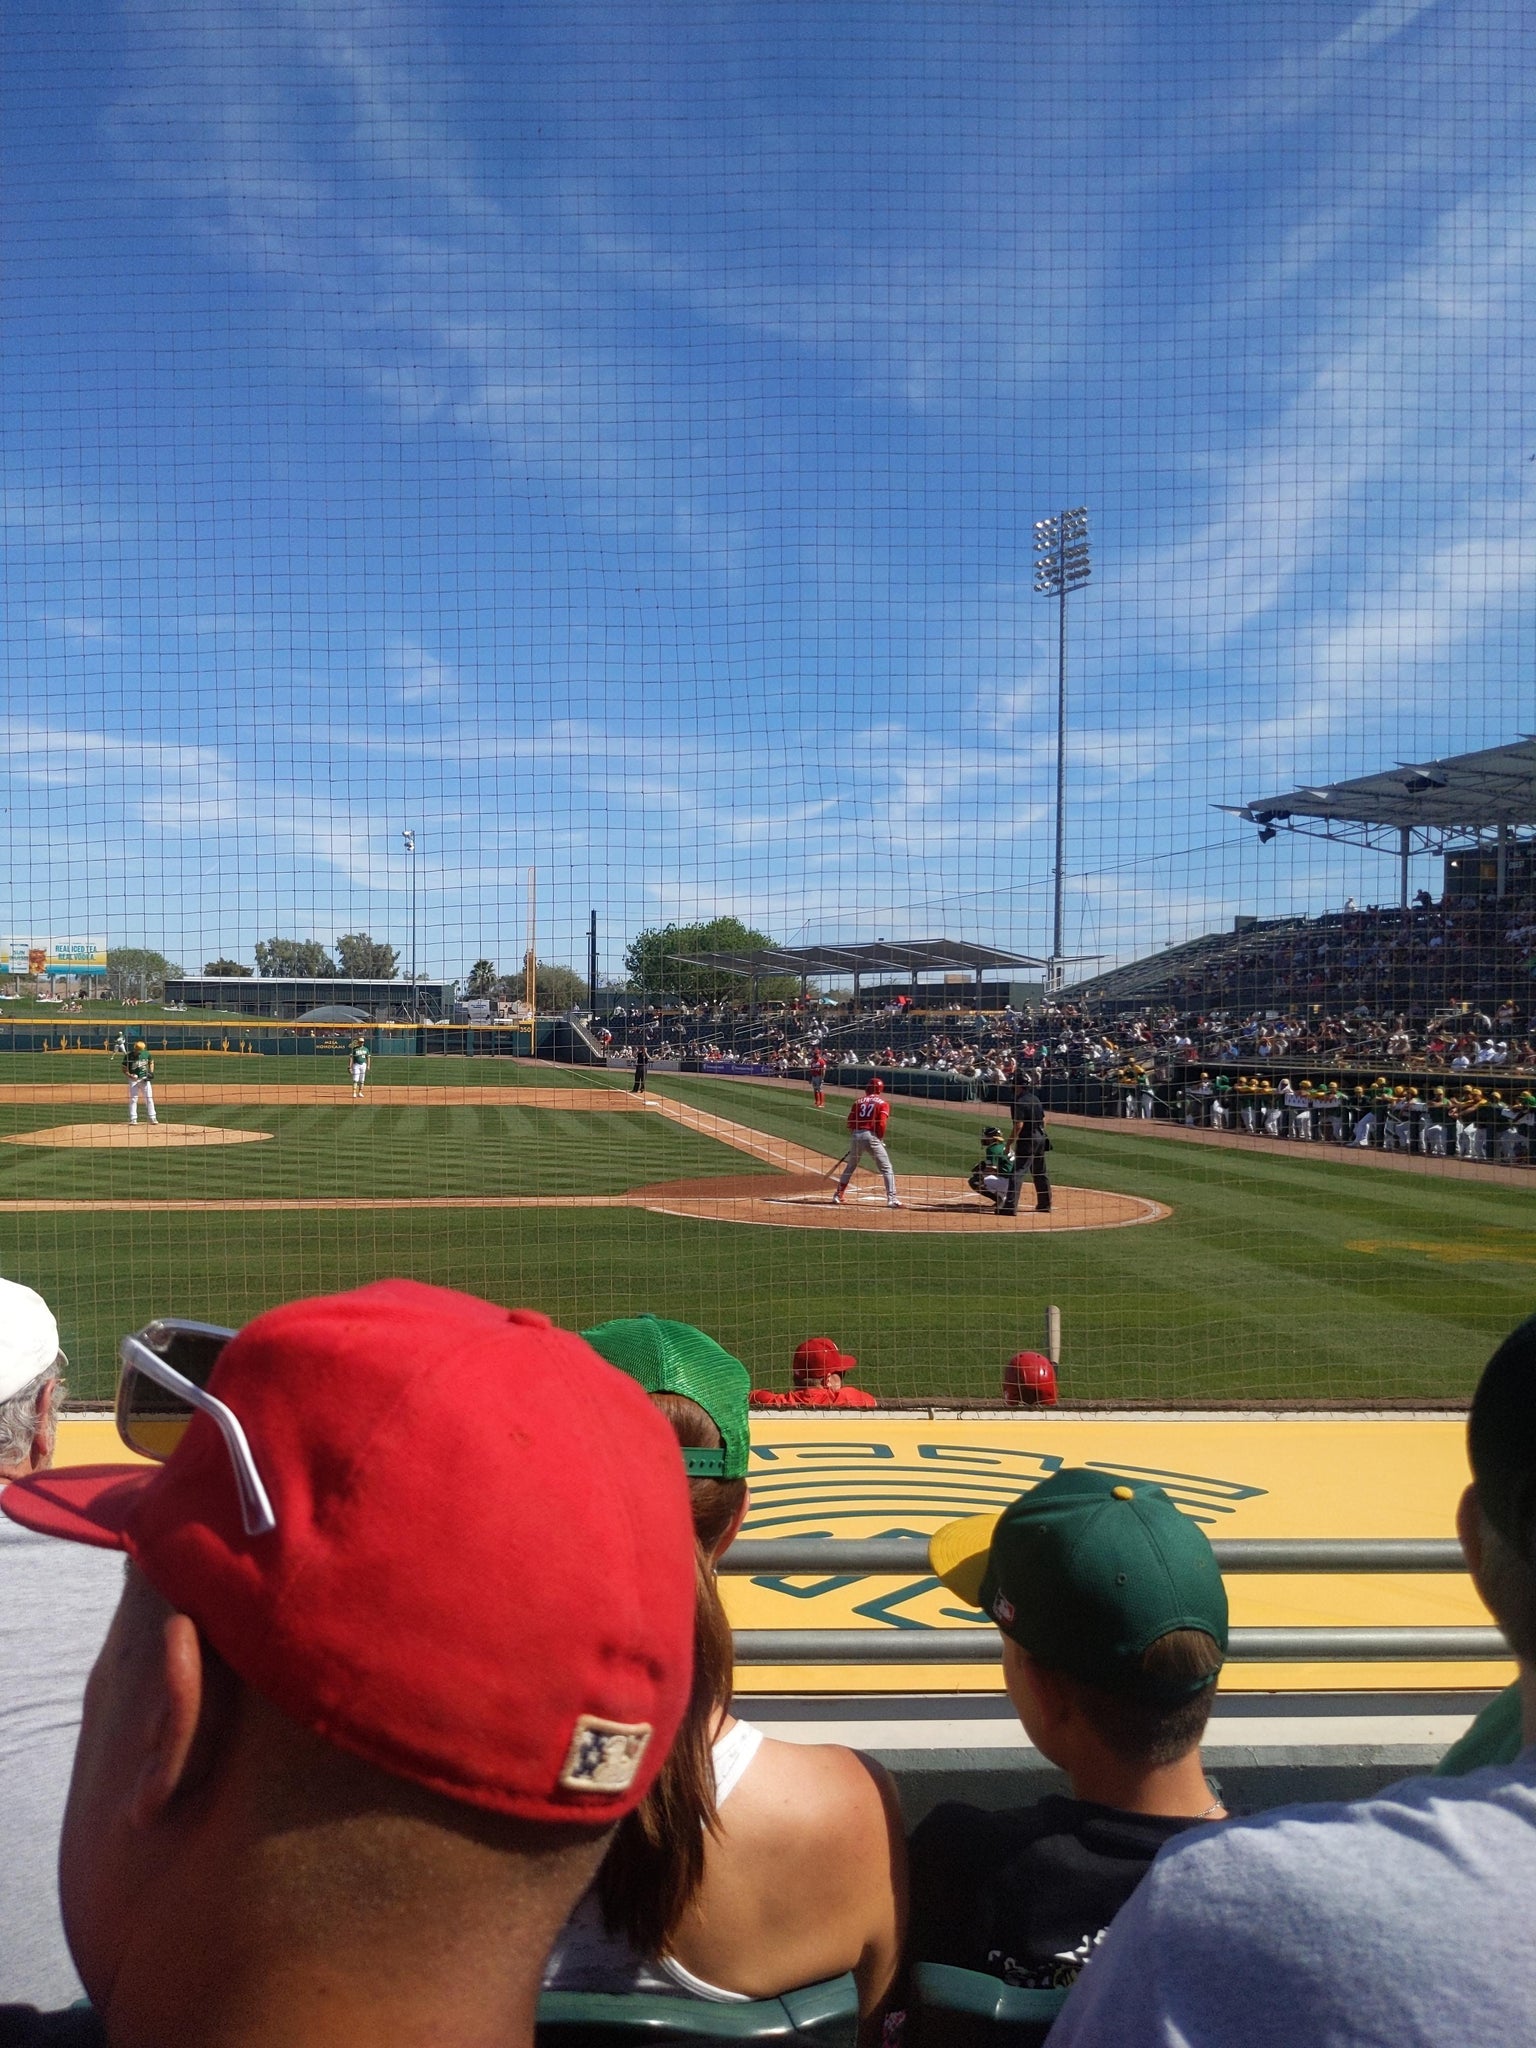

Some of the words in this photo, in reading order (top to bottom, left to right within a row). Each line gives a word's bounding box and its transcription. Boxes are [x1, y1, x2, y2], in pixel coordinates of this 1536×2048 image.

[56, 945, 70, 953] REAL
[71, 945, 85, 953] ICED
[859, 1103, 874, 1117] 37
